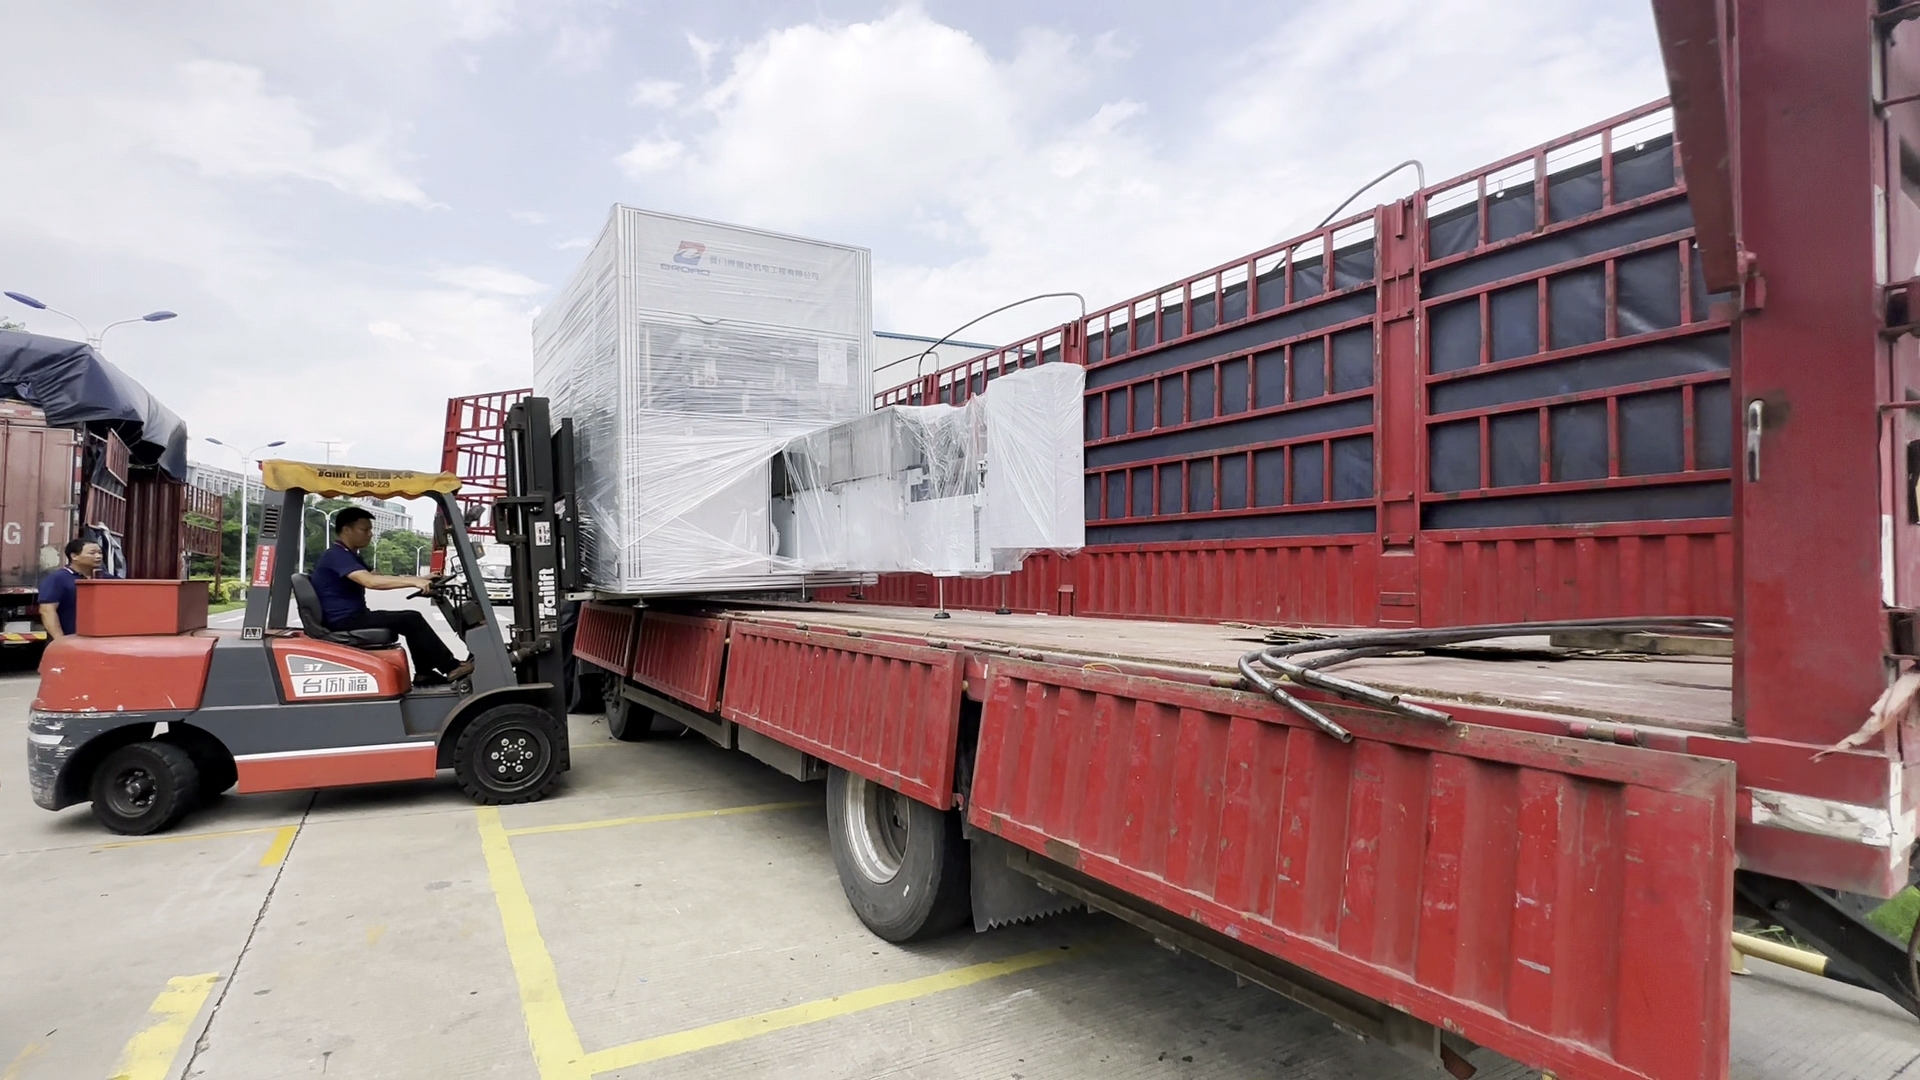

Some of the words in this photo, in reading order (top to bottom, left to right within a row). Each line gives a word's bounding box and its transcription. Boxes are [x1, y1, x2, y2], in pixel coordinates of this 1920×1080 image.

[537, 567, 557, 619] Tailift
[303, 663, 323, 672] 37
[302, 675, 368, 694] 台励福
